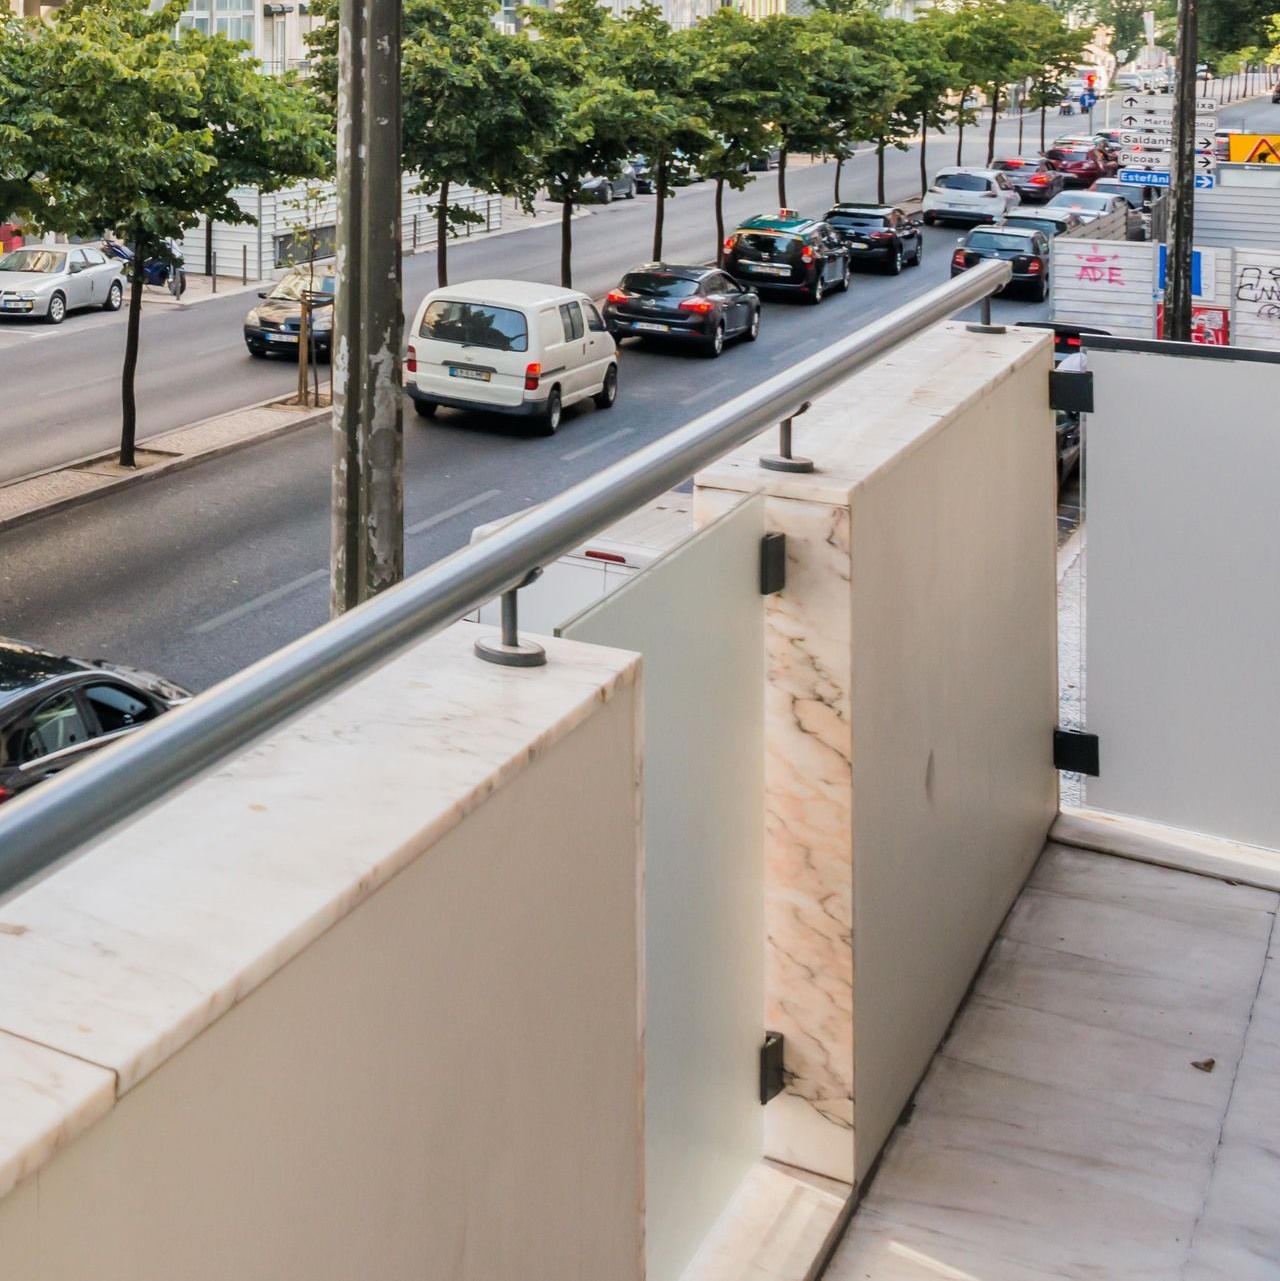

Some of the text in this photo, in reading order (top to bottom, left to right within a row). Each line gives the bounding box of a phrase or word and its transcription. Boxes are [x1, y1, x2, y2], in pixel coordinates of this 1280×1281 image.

[1144, 118, 1172, 126] Marti
[1123, 135, 1172, 145] Saldanh
[1122, 154, 1160, 164] Picoas
[1120, 172, 1169, 184] Estefâni
